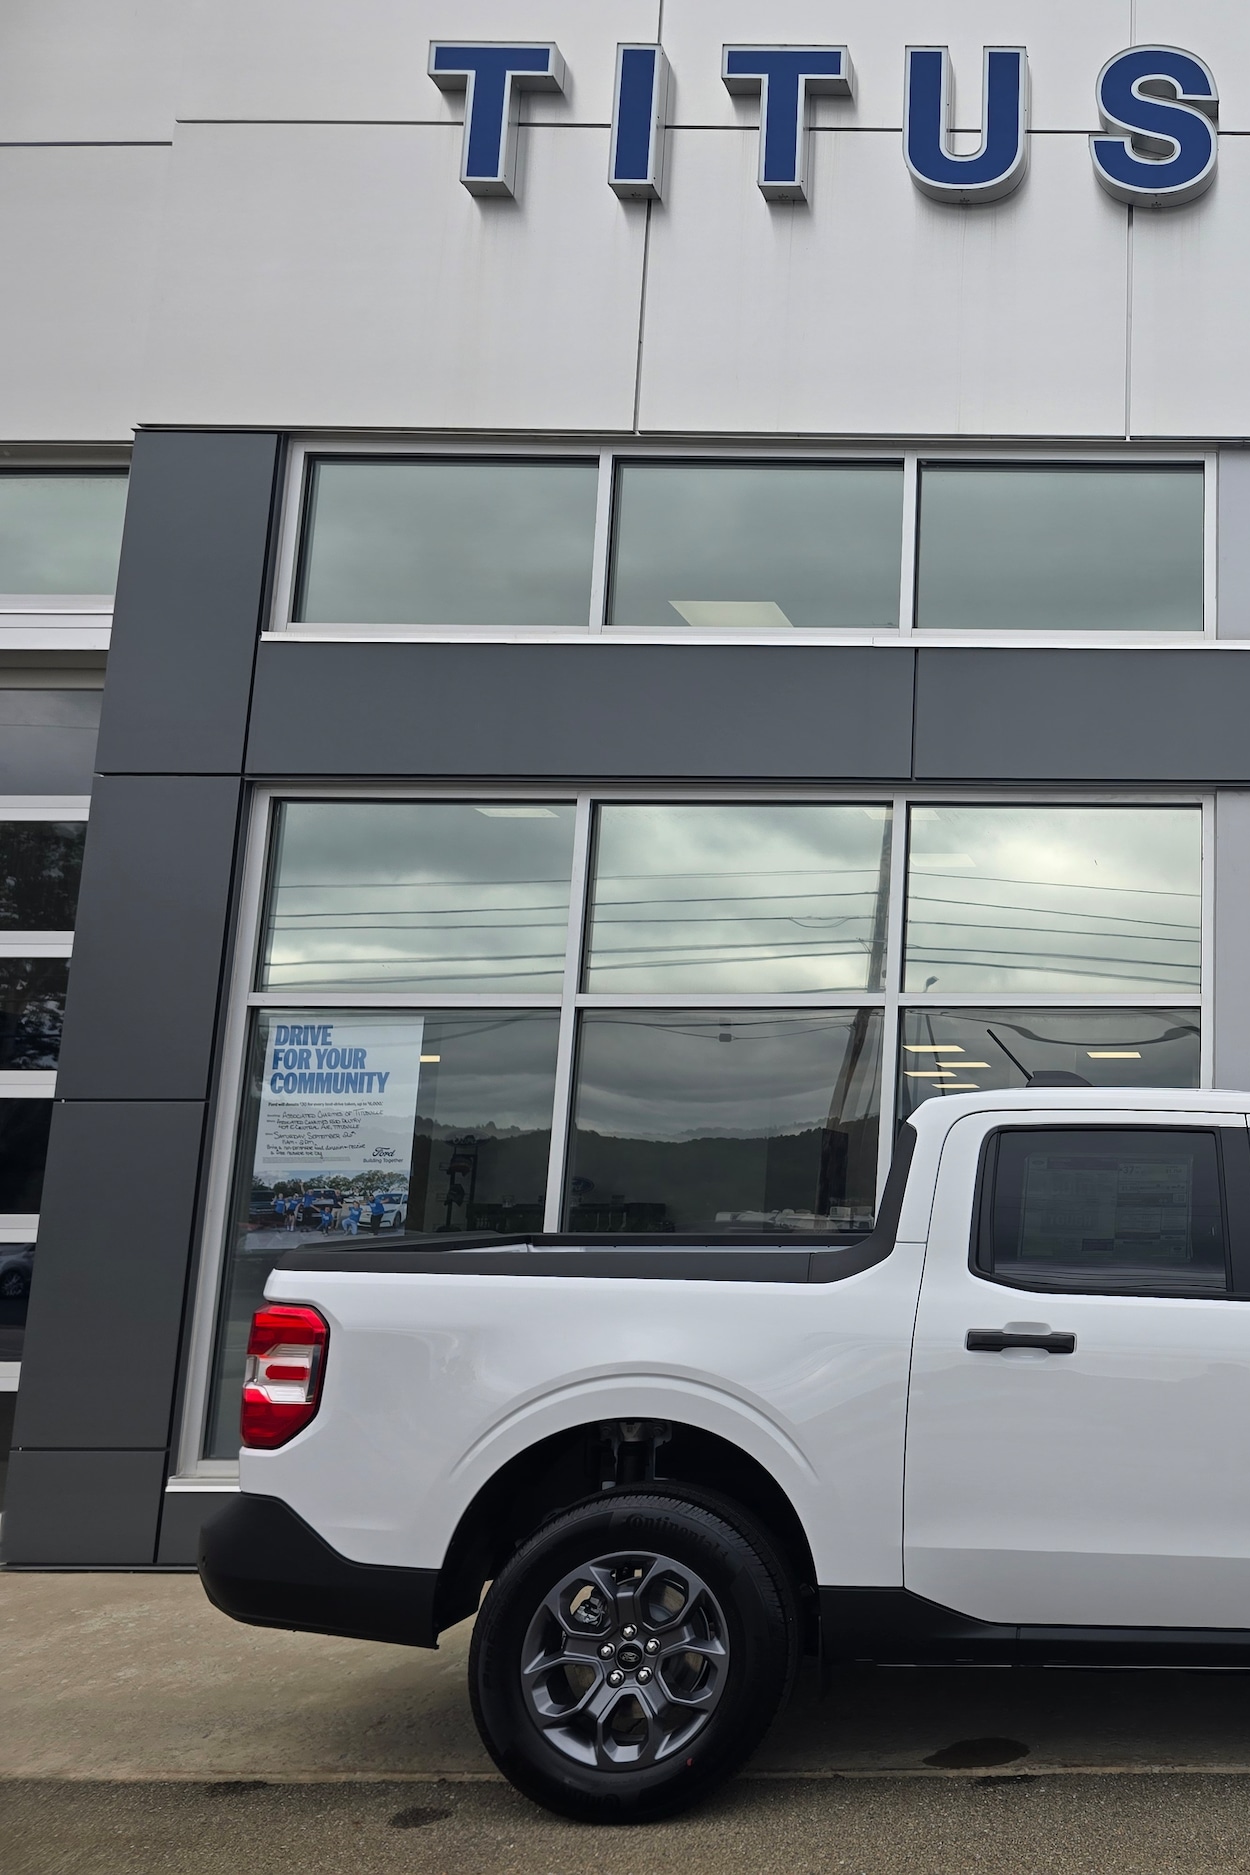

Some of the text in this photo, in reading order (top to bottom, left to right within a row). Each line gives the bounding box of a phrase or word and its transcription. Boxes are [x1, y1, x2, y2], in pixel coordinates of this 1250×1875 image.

[274, 1024, 334, 1046] DRIVE
[272, 1047, 367, 1070] FOR YOUR
[270, 1071, 391, 1094] COMMUNITY
[372, 1147, 396, 1157] Ford
[625, 1512, 723, 1558] Continental
